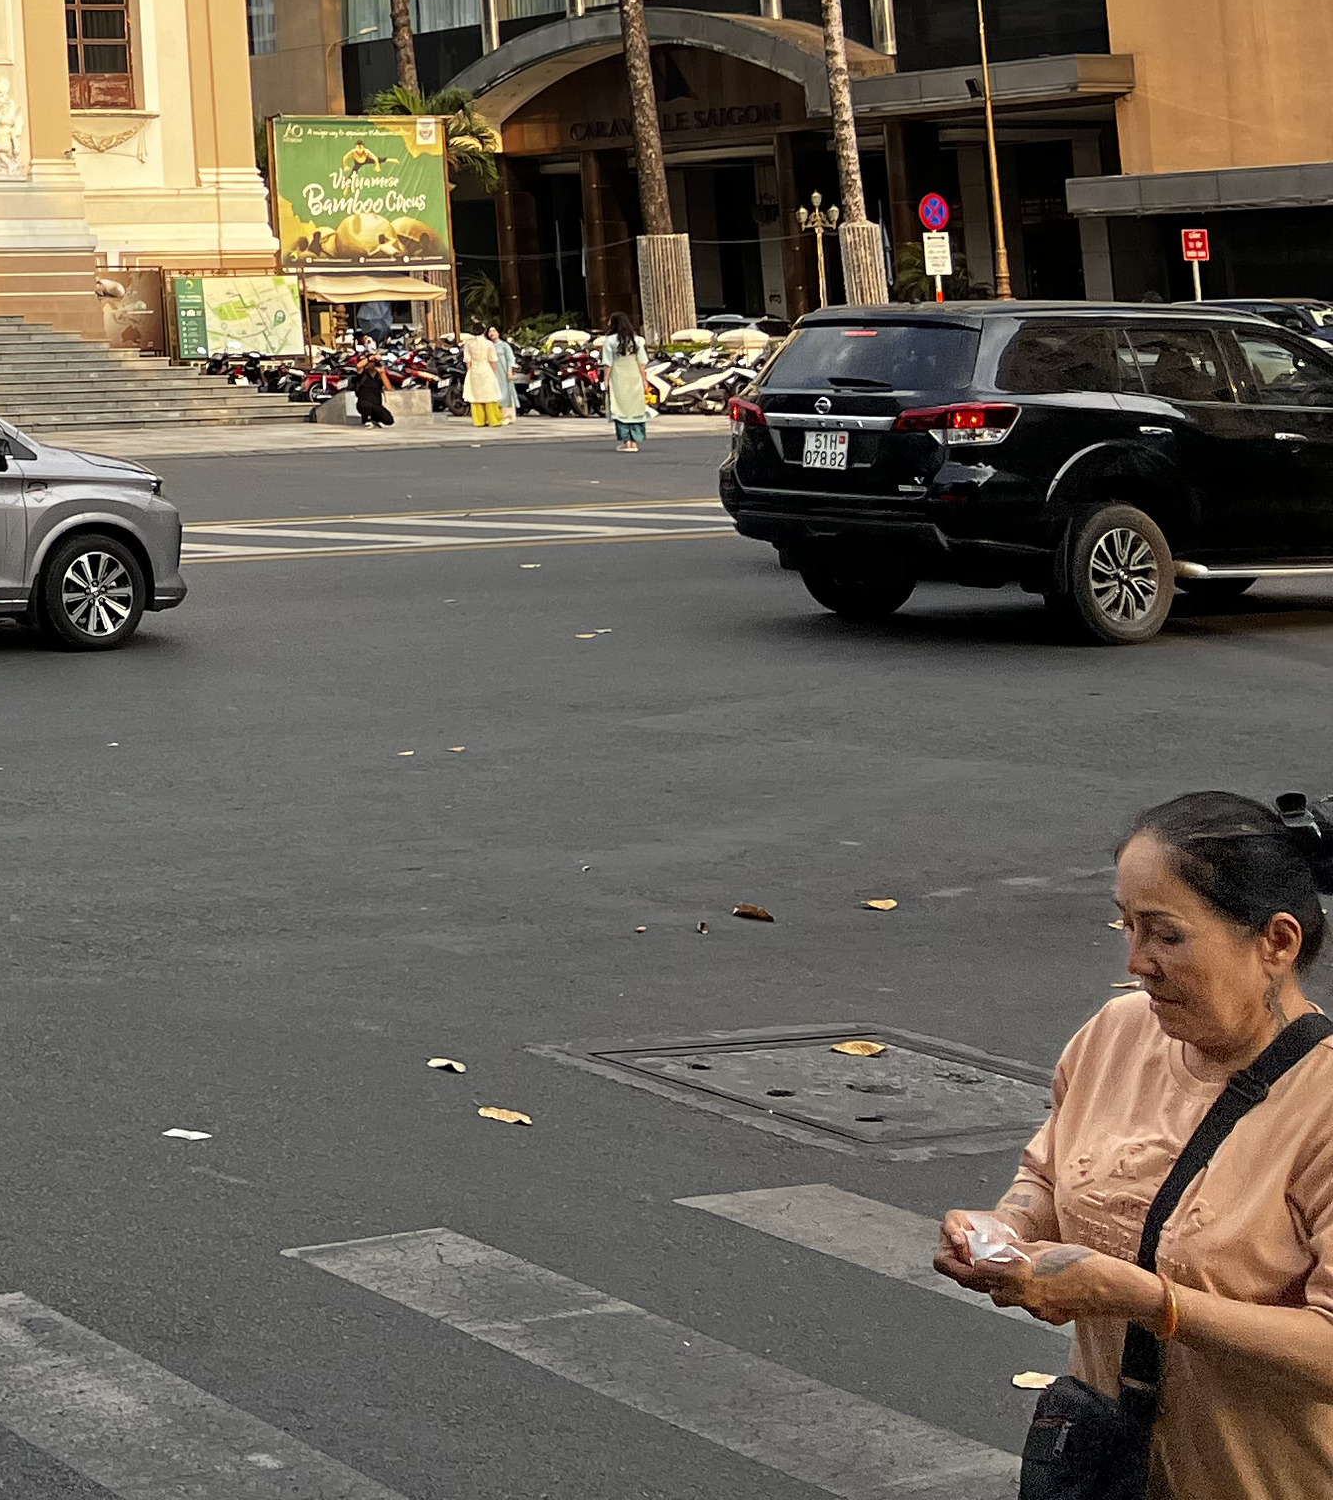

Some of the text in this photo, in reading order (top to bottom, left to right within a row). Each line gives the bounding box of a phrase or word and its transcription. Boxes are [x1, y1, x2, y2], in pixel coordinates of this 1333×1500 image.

[570, 102, 783, 141] CARAVLE SAIGON
[329, 167, 400, 194] Vietnamese
[302, 183, 427, 216] Bamboo Circus
[814, 433, 838, 451] 51H
